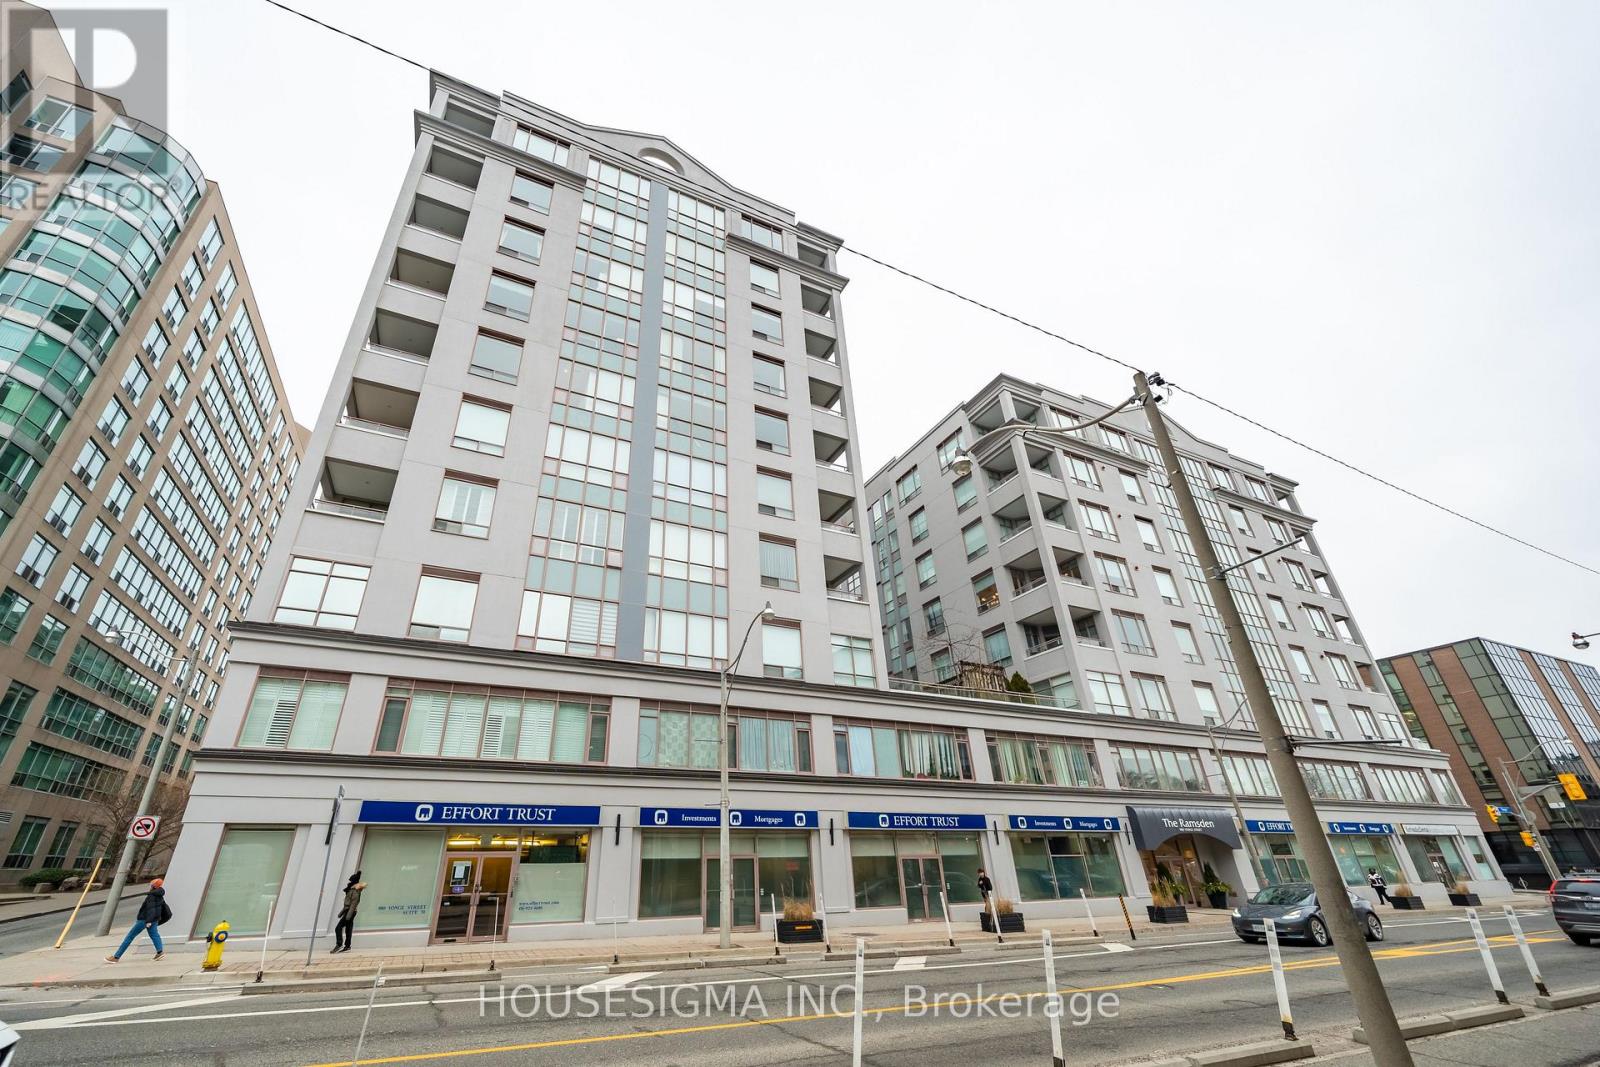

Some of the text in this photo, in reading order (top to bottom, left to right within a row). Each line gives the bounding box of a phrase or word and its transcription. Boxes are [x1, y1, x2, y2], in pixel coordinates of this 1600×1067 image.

[441, 806, 556, 821] EFFORT TRUST
[681, 813, 717, 822] Investments
[754, 815, 783, 825] Mortgages
[893, 815, 959, 827] EFFORT TRUST
[1162, 818, 1215, 829] The Ramsden
